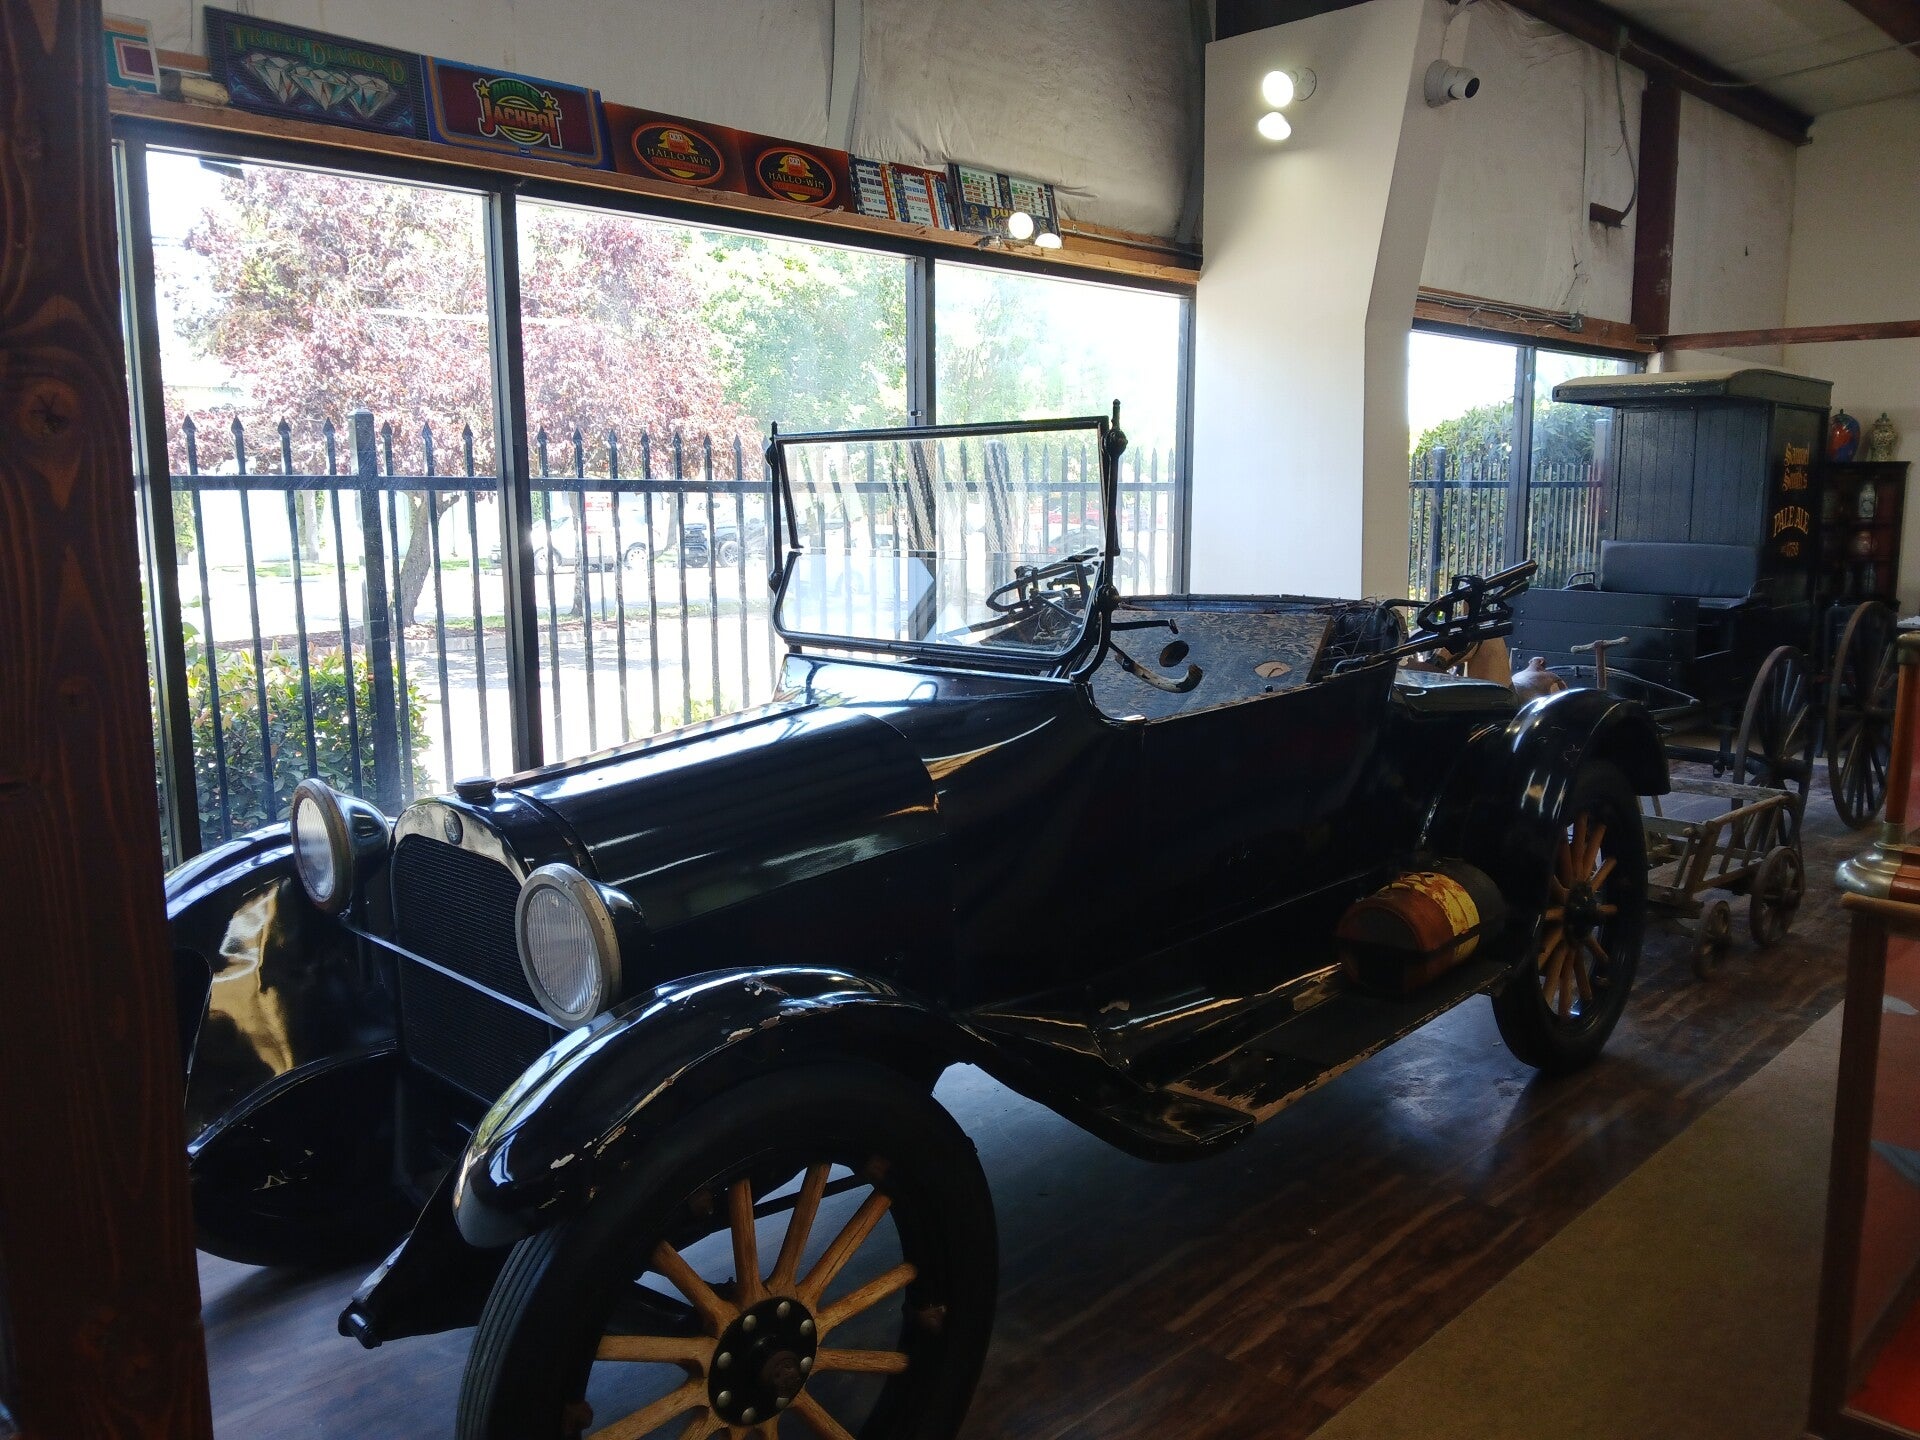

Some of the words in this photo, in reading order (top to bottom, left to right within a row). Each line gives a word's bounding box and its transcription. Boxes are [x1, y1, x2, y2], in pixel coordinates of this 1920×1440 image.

[233, 25, 308, 56] TRIPLE
[311, 41, 406, 83] DIAMOND
[492, 81, 541, 102] DOUBLE
[481, 97, 559, 145] JACKPOT
[646, 147, 711, 167] HALLO-WIN
[768, 171, 825, 189] HALLO-WIN
[1773, 506, 1795, 537] PALE
[1794, 507, 1809, 535] ALE
